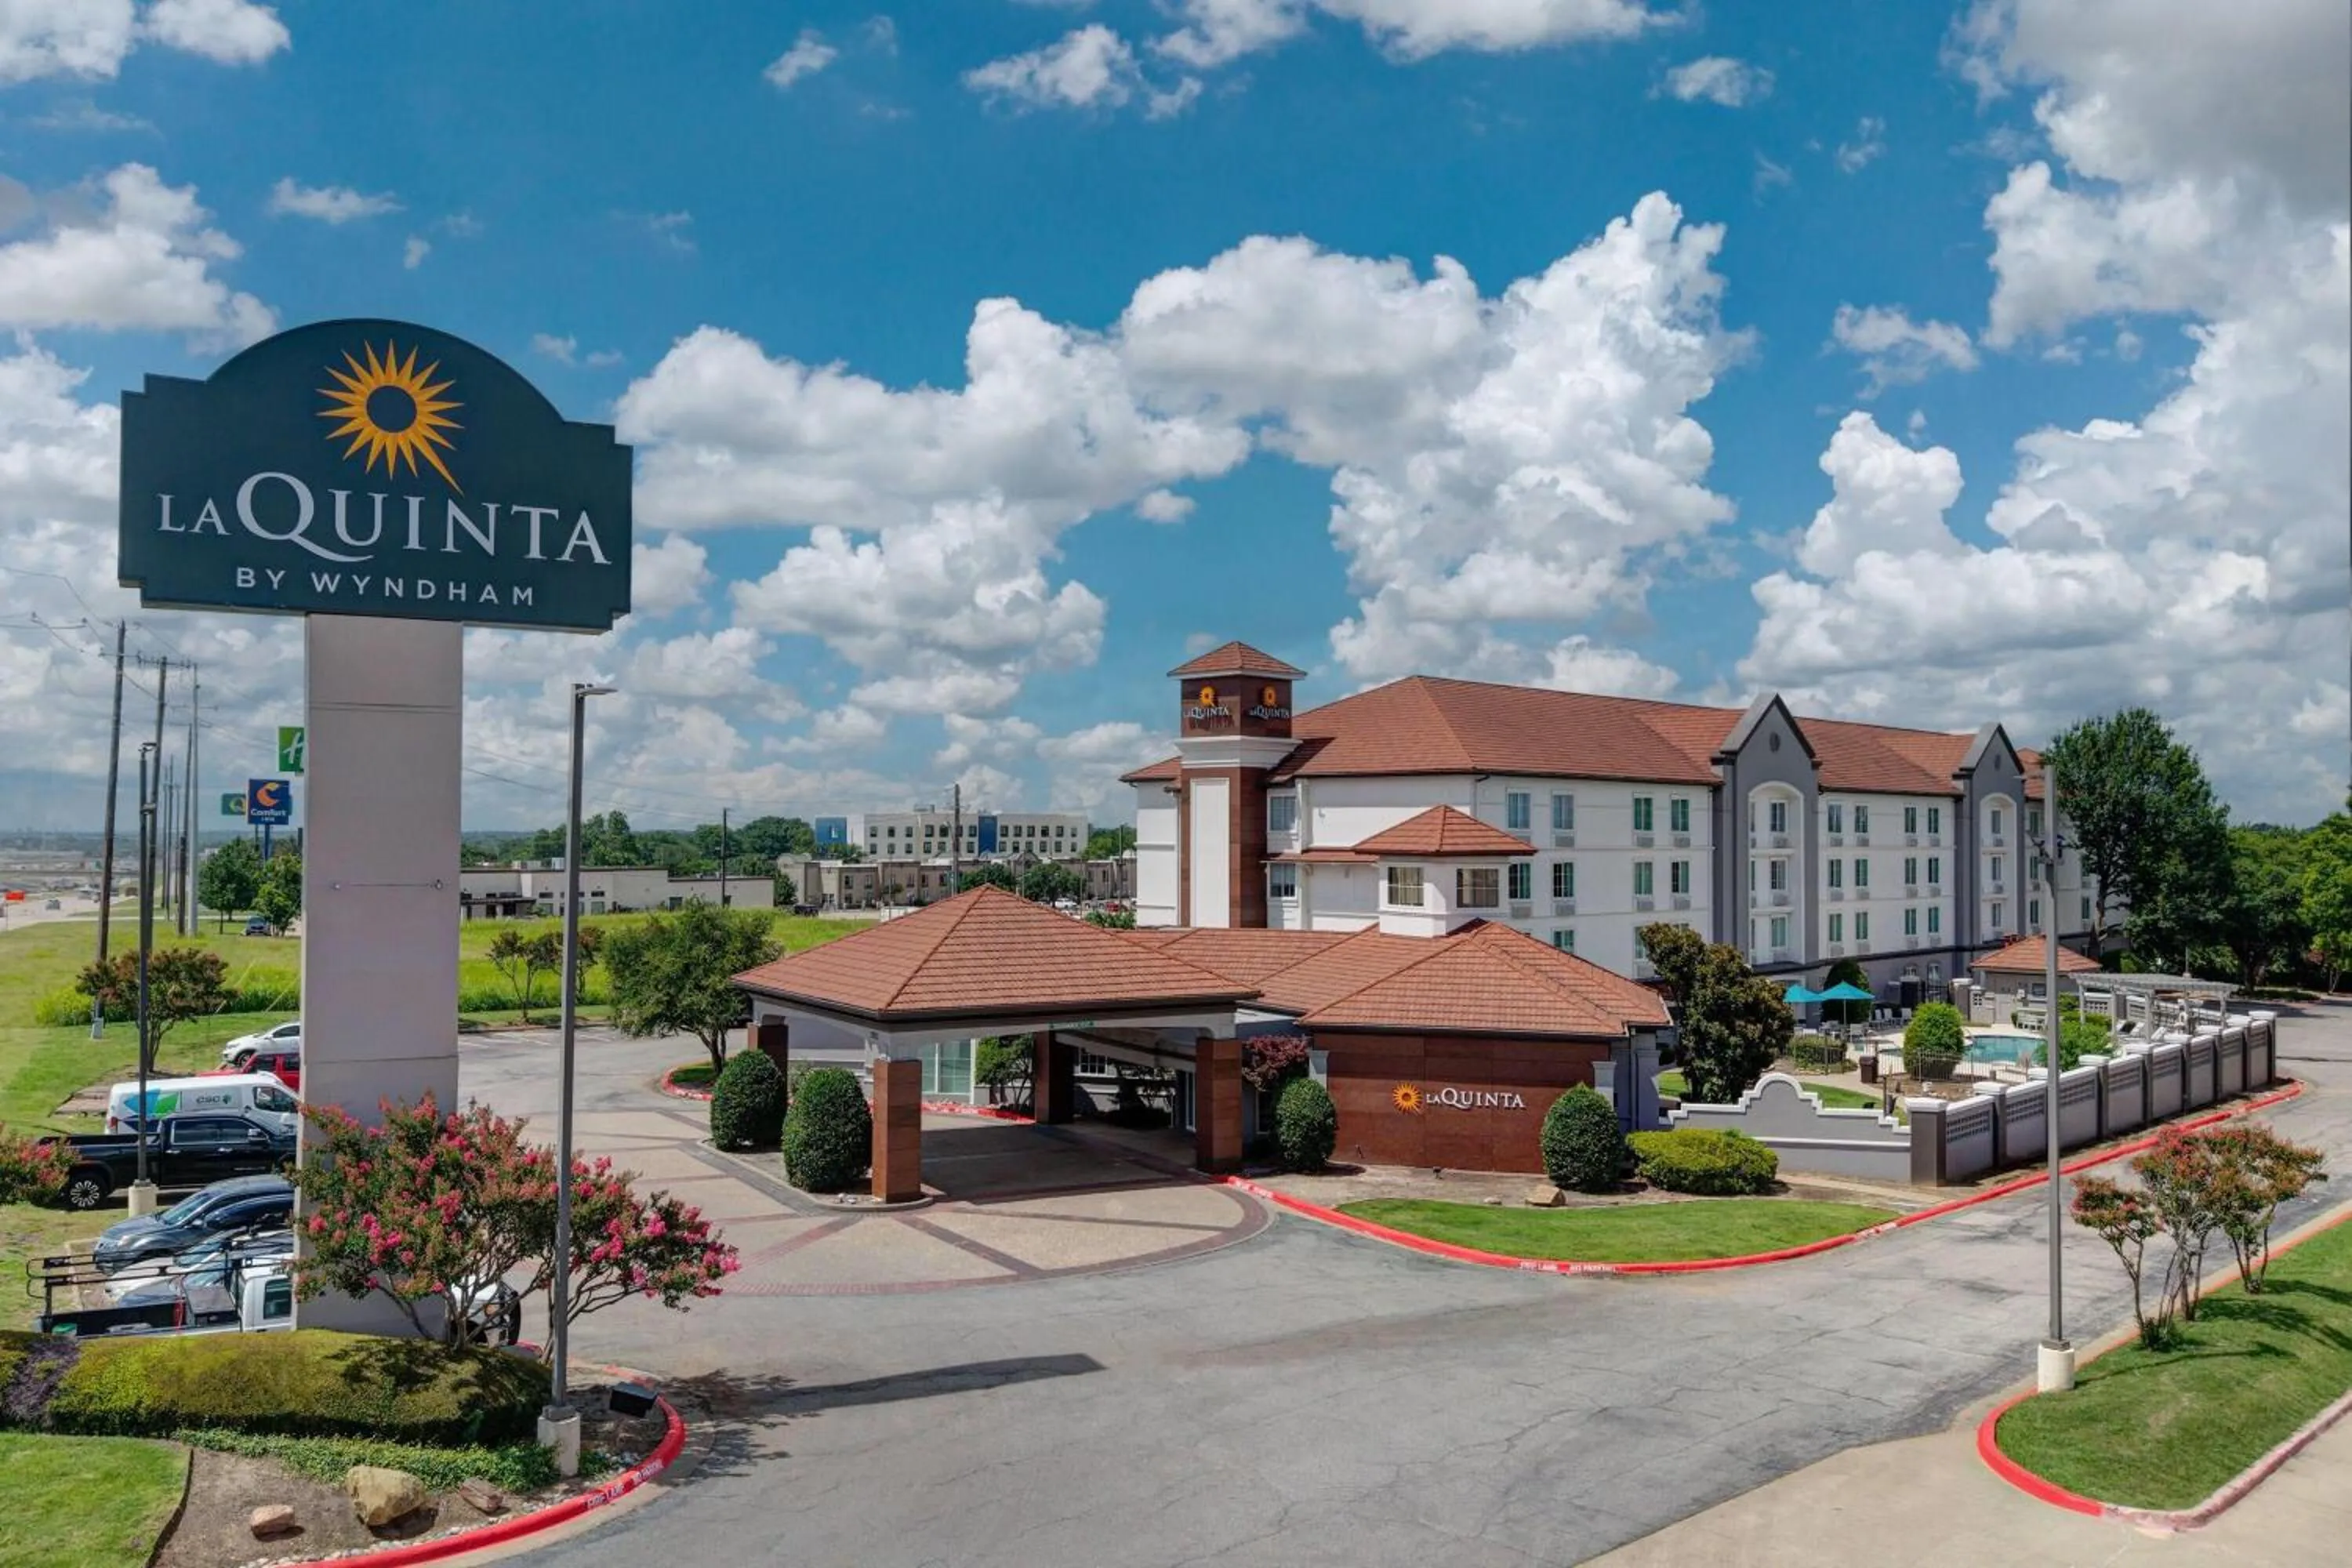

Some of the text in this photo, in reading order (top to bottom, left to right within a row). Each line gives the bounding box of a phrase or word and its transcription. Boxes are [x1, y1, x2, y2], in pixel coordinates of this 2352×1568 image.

[157, 470, 612, 564] LA QUINTA
[236, 566, 534, 607] BY WYNDHAM
[1191, 706, 1229, 720] QUINTA
[1257, 705, 1290, 720] QUINTA
[1425, 1087, 1526, 1110] LA QUINTA
